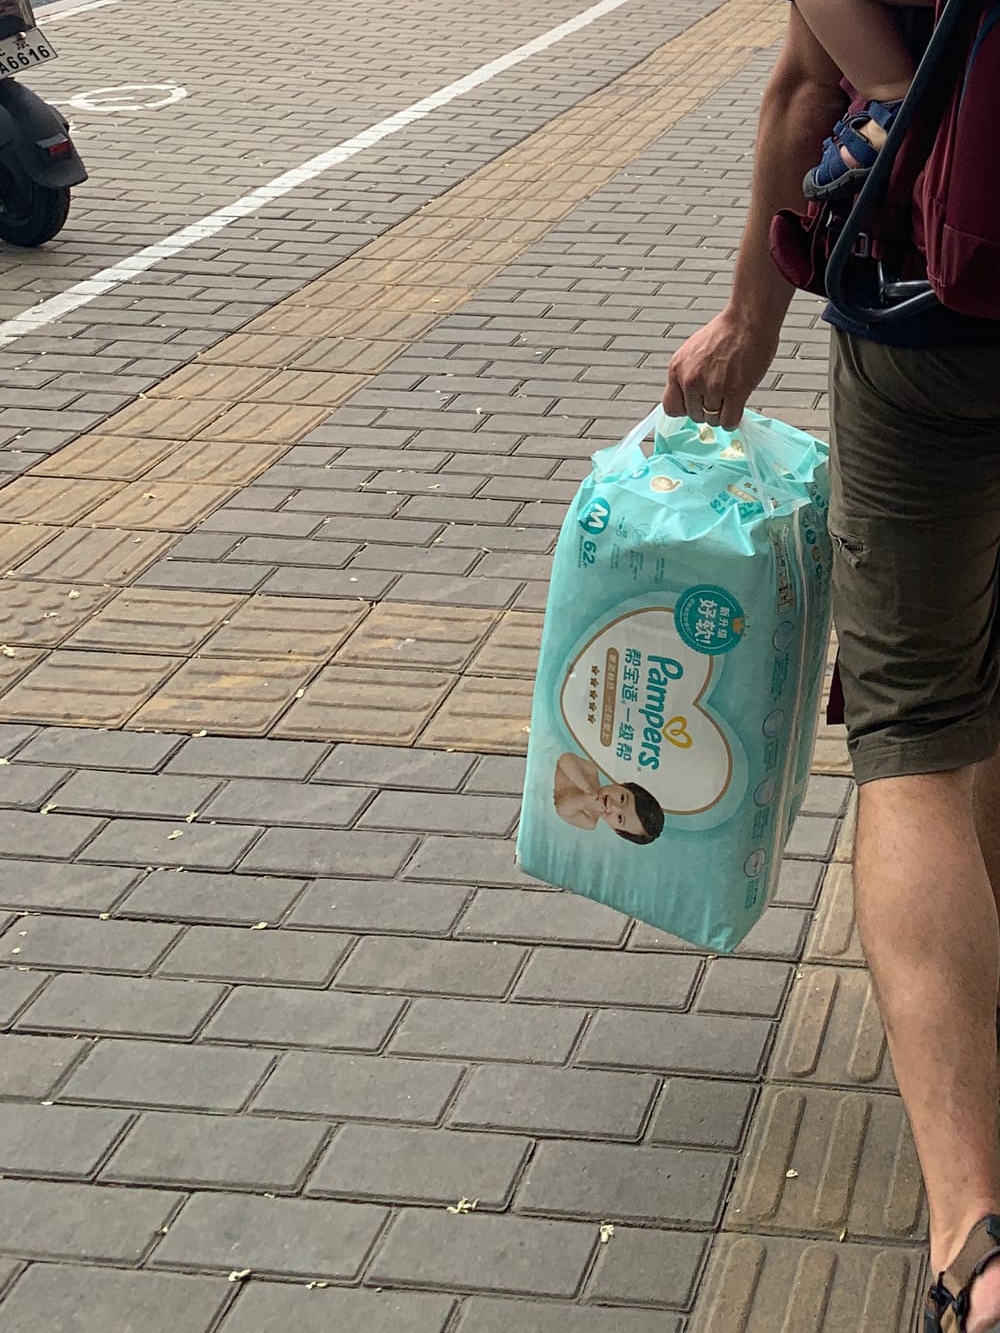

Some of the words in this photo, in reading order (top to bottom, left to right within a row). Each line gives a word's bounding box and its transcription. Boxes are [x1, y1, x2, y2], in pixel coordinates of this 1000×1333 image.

[588, 503, 609, 528] M
[717, 607, 730, 639] 新升级
[638, 655, 684, 770] Pampers
